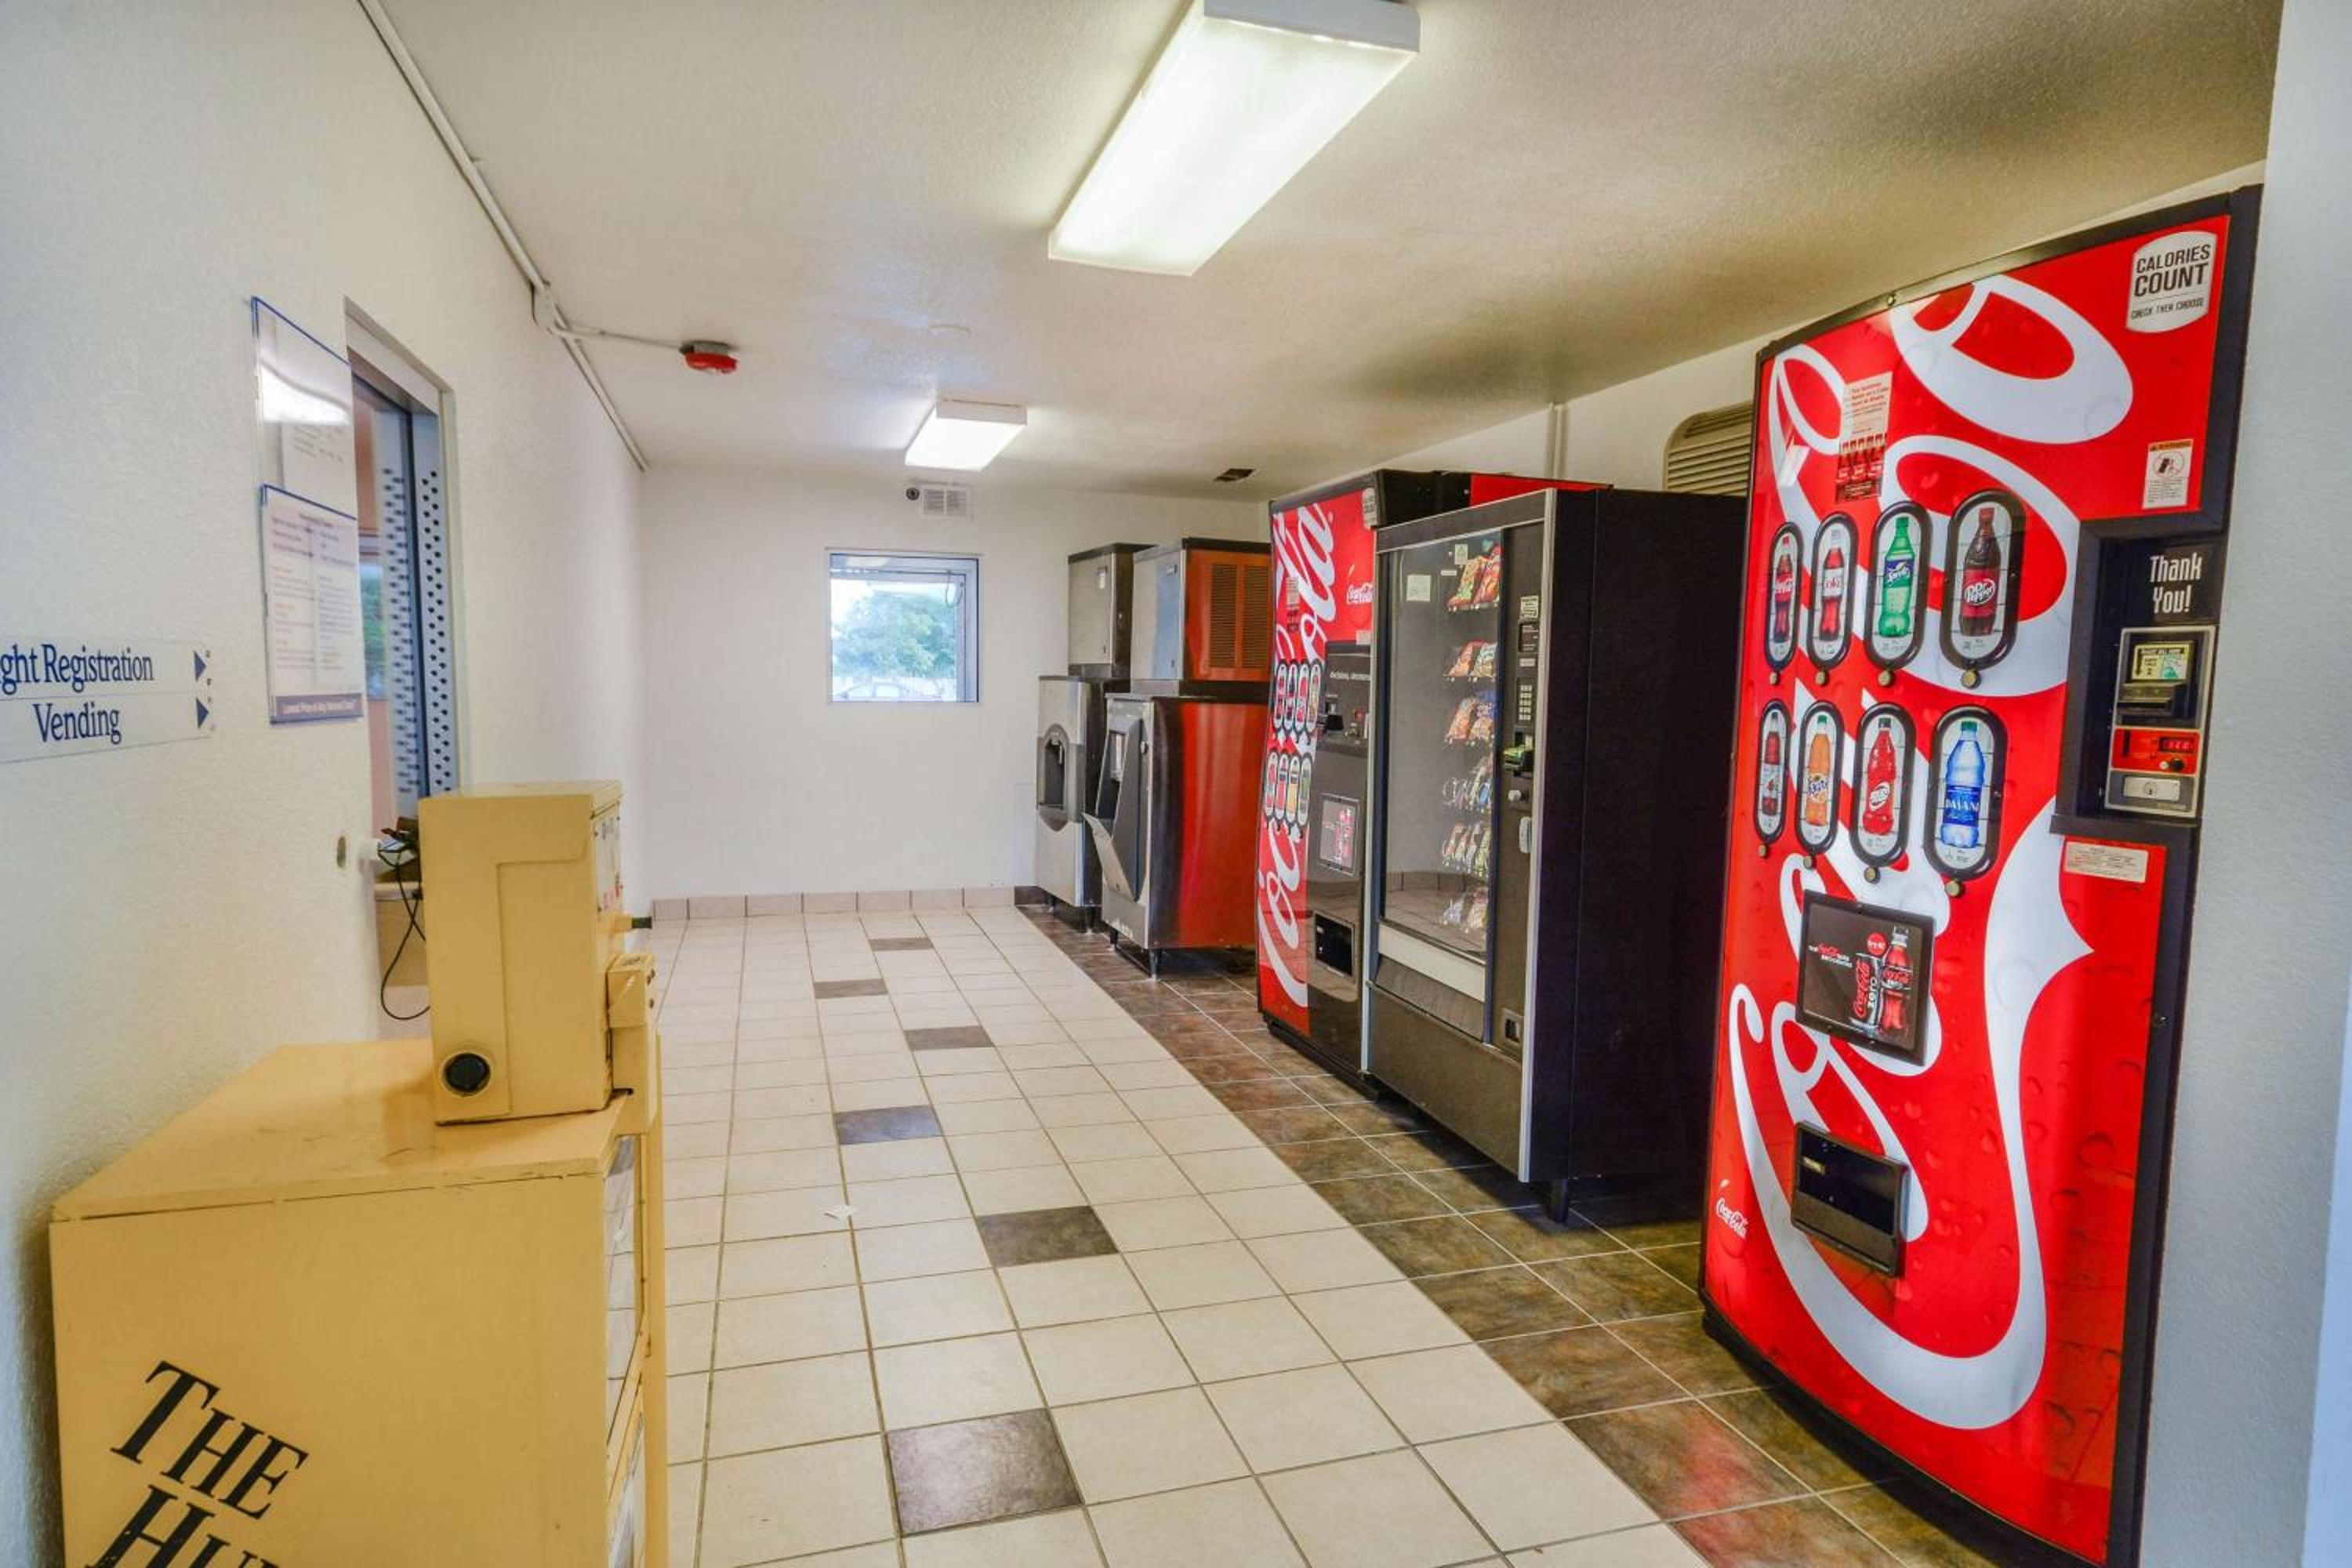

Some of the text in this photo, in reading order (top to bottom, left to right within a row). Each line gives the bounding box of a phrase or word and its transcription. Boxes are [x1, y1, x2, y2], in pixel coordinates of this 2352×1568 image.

[2136, 244, 2211, 274] CALORIES
[2133, 262, 2209, 297] COUNT
[2149, 552, 2203, 583] Thank
[2153, 584, 2193, 615] You!
[0, 643, 154, 695] ght Registration
[33, 701, 122, 745] Vending
[110, 1360, 309, 1519] THE
